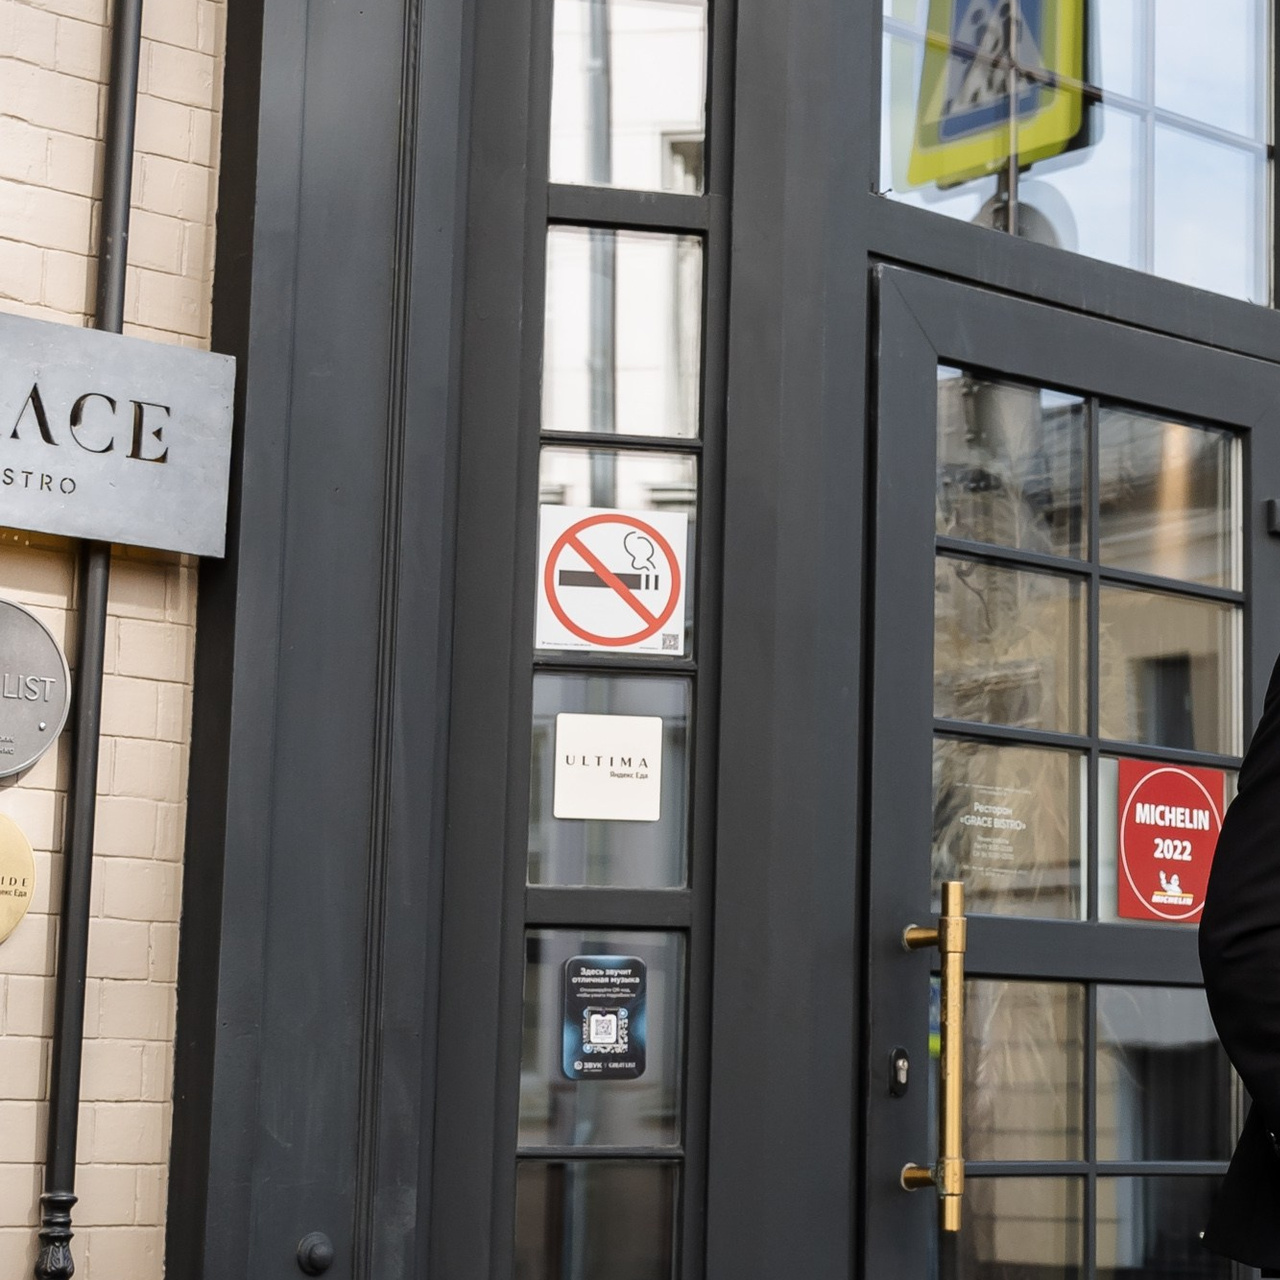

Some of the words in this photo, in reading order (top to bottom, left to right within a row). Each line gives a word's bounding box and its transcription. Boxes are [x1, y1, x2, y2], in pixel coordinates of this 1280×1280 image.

[0, 382, 171, 464] ACE
[3, 673, 57, 702] LIST
[565, 754, 649, 768] ULTIMA
[1135, 802, 1210, 831] MICHELIN
[1153, 837, 1192, 862] 2022
[1151, 894, 1193, 906] MICHELIN
[580, 967, 604, 976] Здесь
[605, 969, 632, 977] звучит
